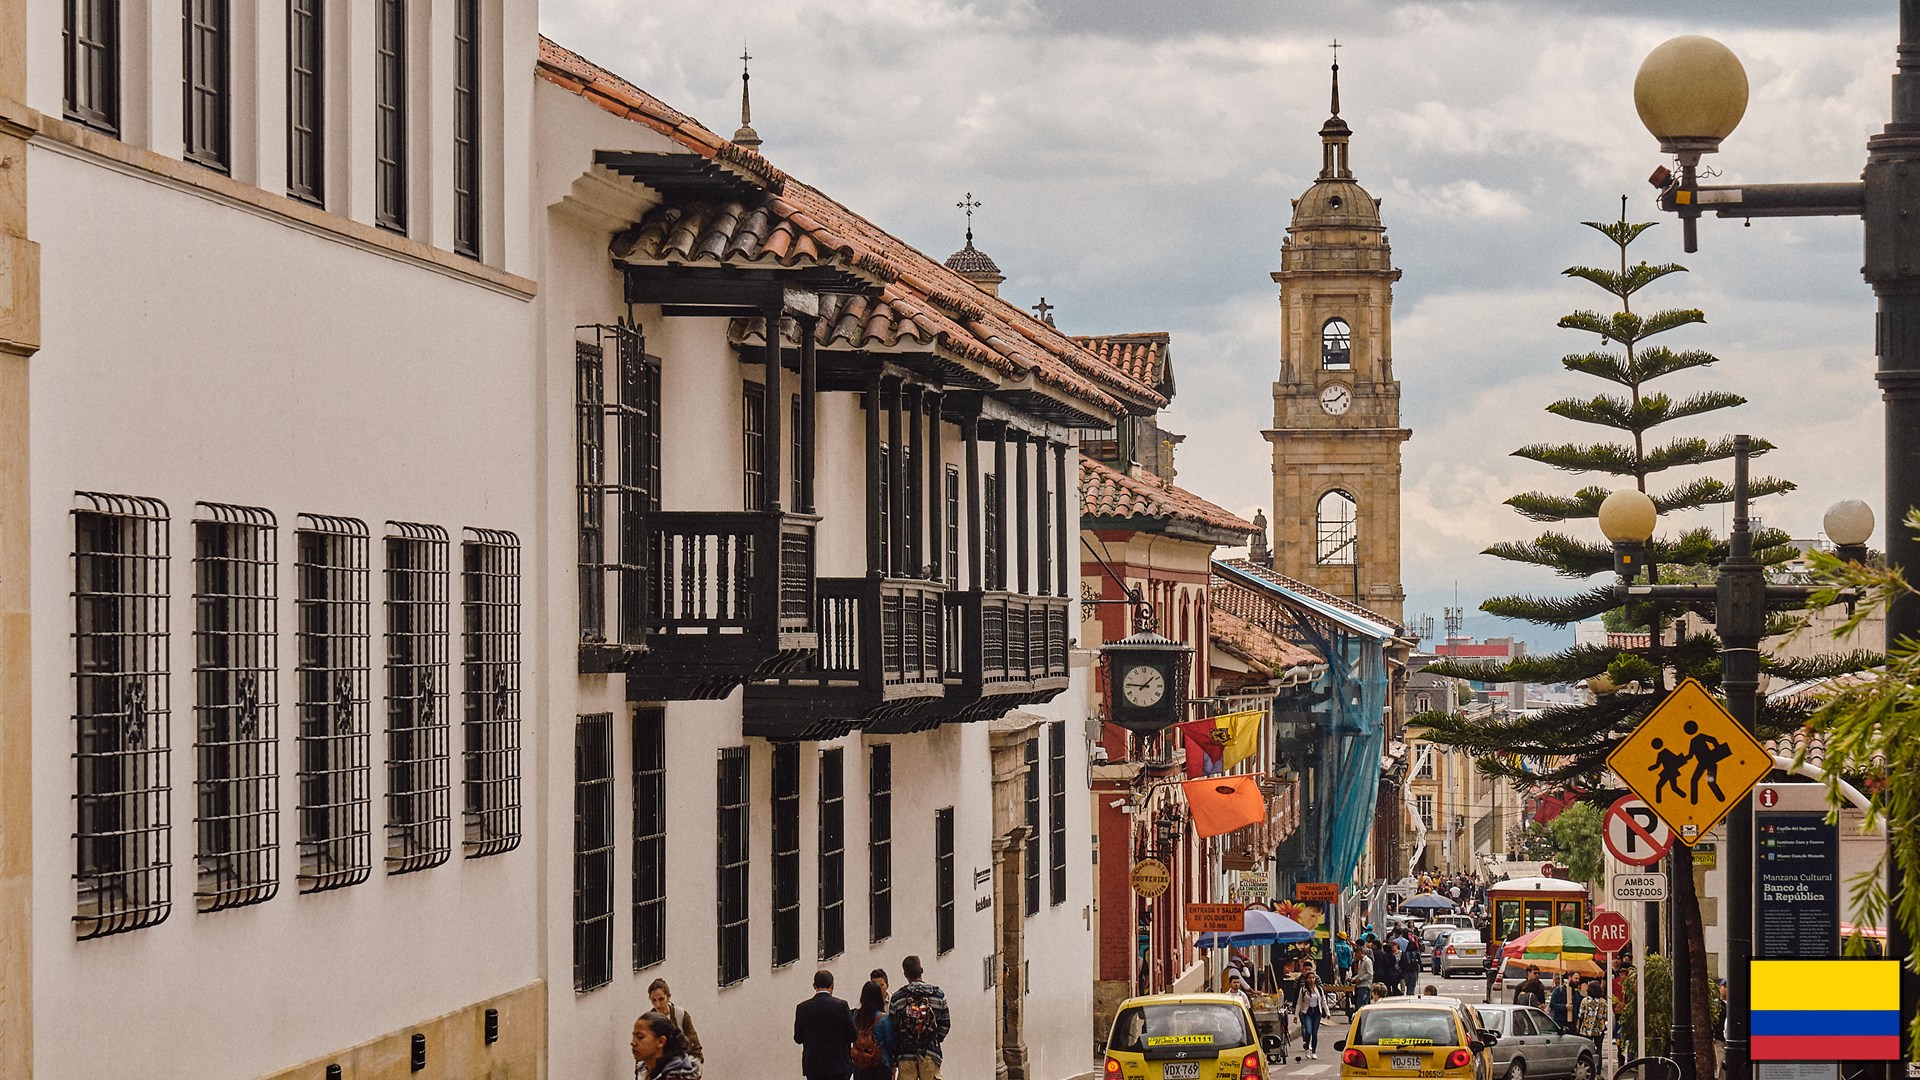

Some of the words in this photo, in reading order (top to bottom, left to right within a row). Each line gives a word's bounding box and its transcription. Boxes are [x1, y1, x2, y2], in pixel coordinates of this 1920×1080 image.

[1626, 807, 1658, 852] P
[1800, 873, 1833, 881] Cultural
[1624, 878, 1655, 886] AMBOS
[1763, 883, 1795, 892] Banco
[1796, 883, 1809, 892] de
[1617, 888, 1663, 897] COSTADOS
[1763, 892, 1774, 901] la
[1775, 892, 1825, 903] República
[1203, 914, 1237, 922] VOLQUETAS
[1593, 924, 1626, 940] PARE
